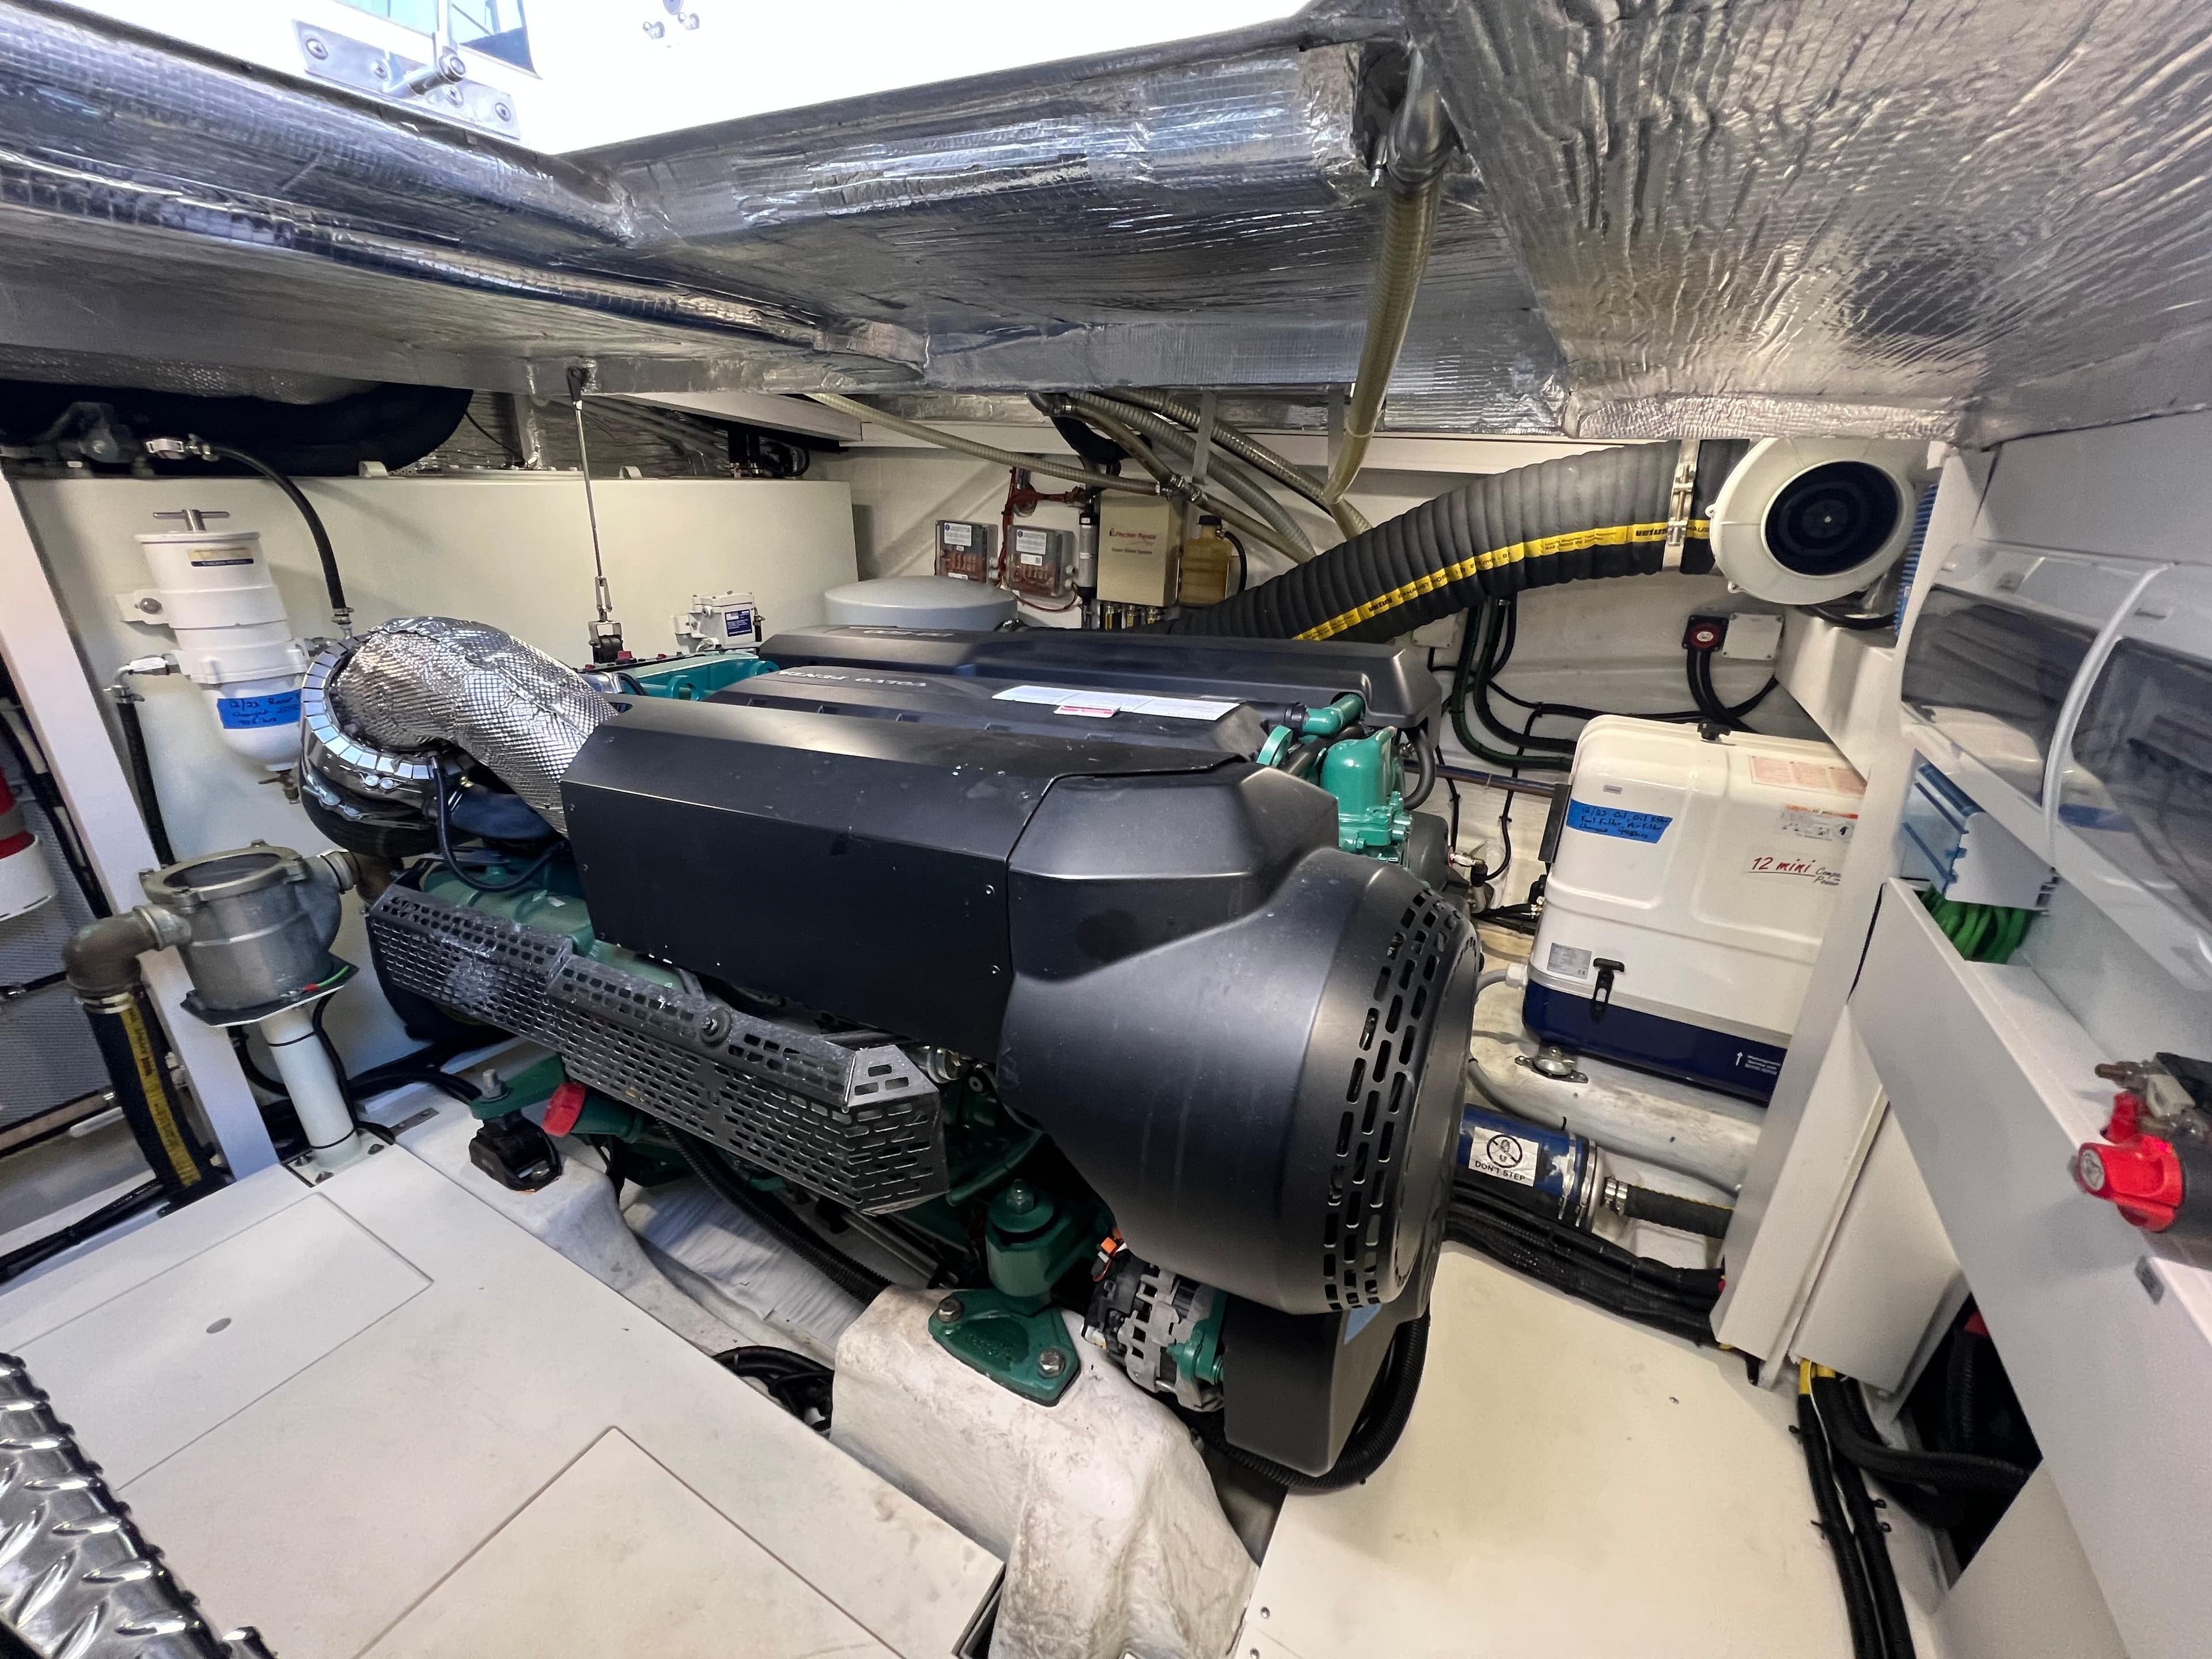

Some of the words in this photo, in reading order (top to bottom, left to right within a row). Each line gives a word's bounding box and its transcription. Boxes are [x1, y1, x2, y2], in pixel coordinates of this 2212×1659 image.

[1752, 857, 1774, 870] 12
[1776, 858, 1816, 873] mini
[1475, 1161, 1501, 1175] DON'T
[1503, 1169, 1526, 1181] STEP
